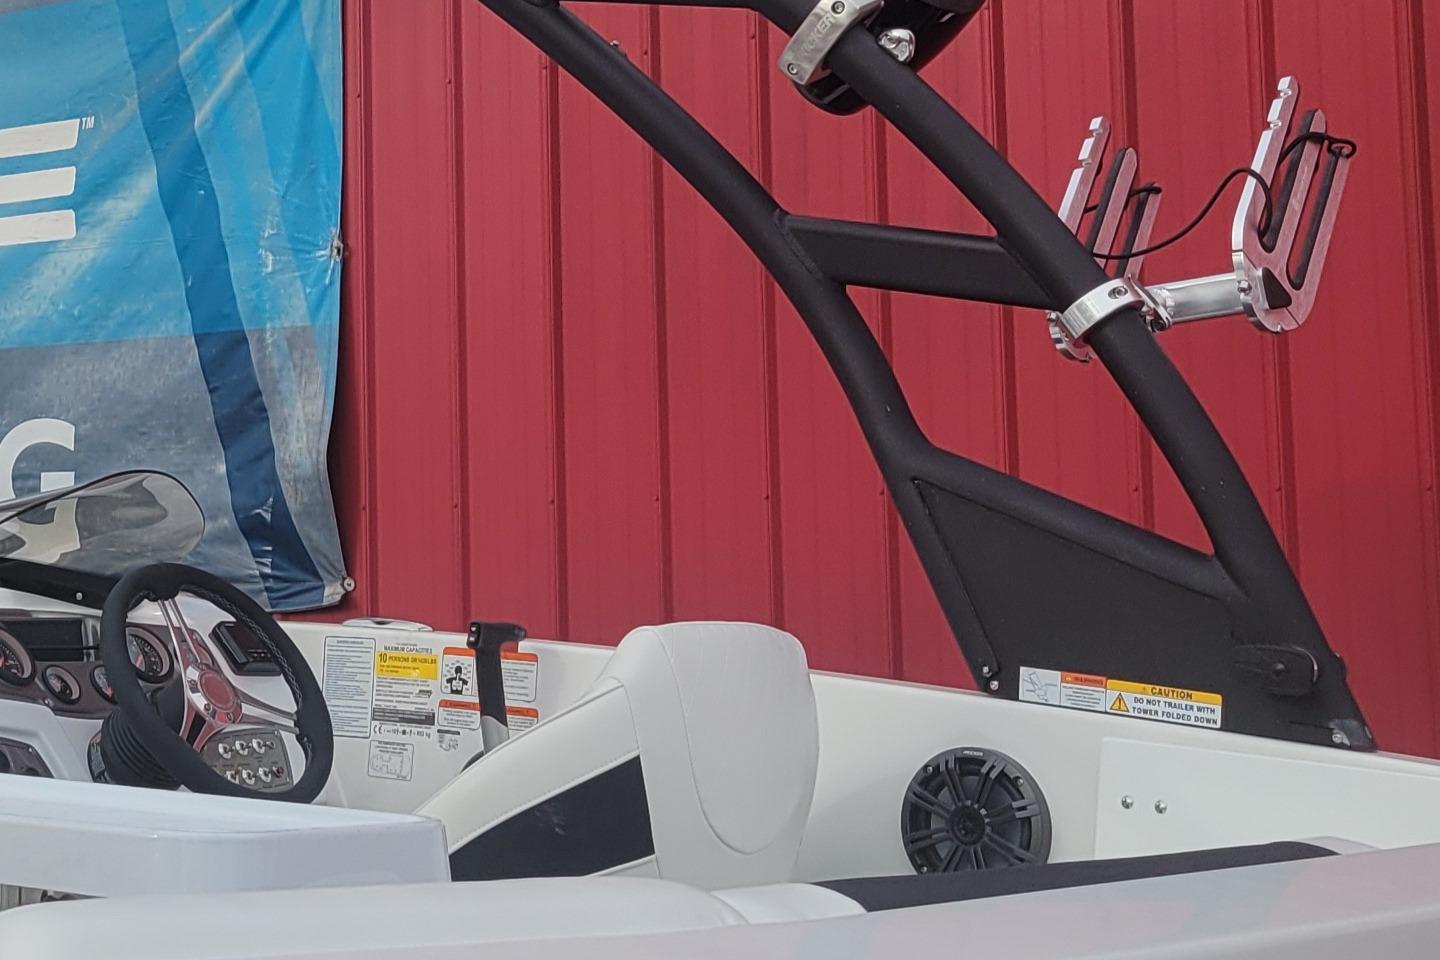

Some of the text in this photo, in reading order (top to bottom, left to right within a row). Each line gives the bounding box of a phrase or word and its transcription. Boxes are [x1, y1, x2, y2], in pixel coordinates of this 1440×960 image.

[379, 652, 388, 663] 10
[1150, 686, 1193, 700] CAUTION
[1133, 696, 1216, 715] DO NOT TRAILER WITH
[1131, 706, 1218, 726] TOWER FOLDED DOWN
